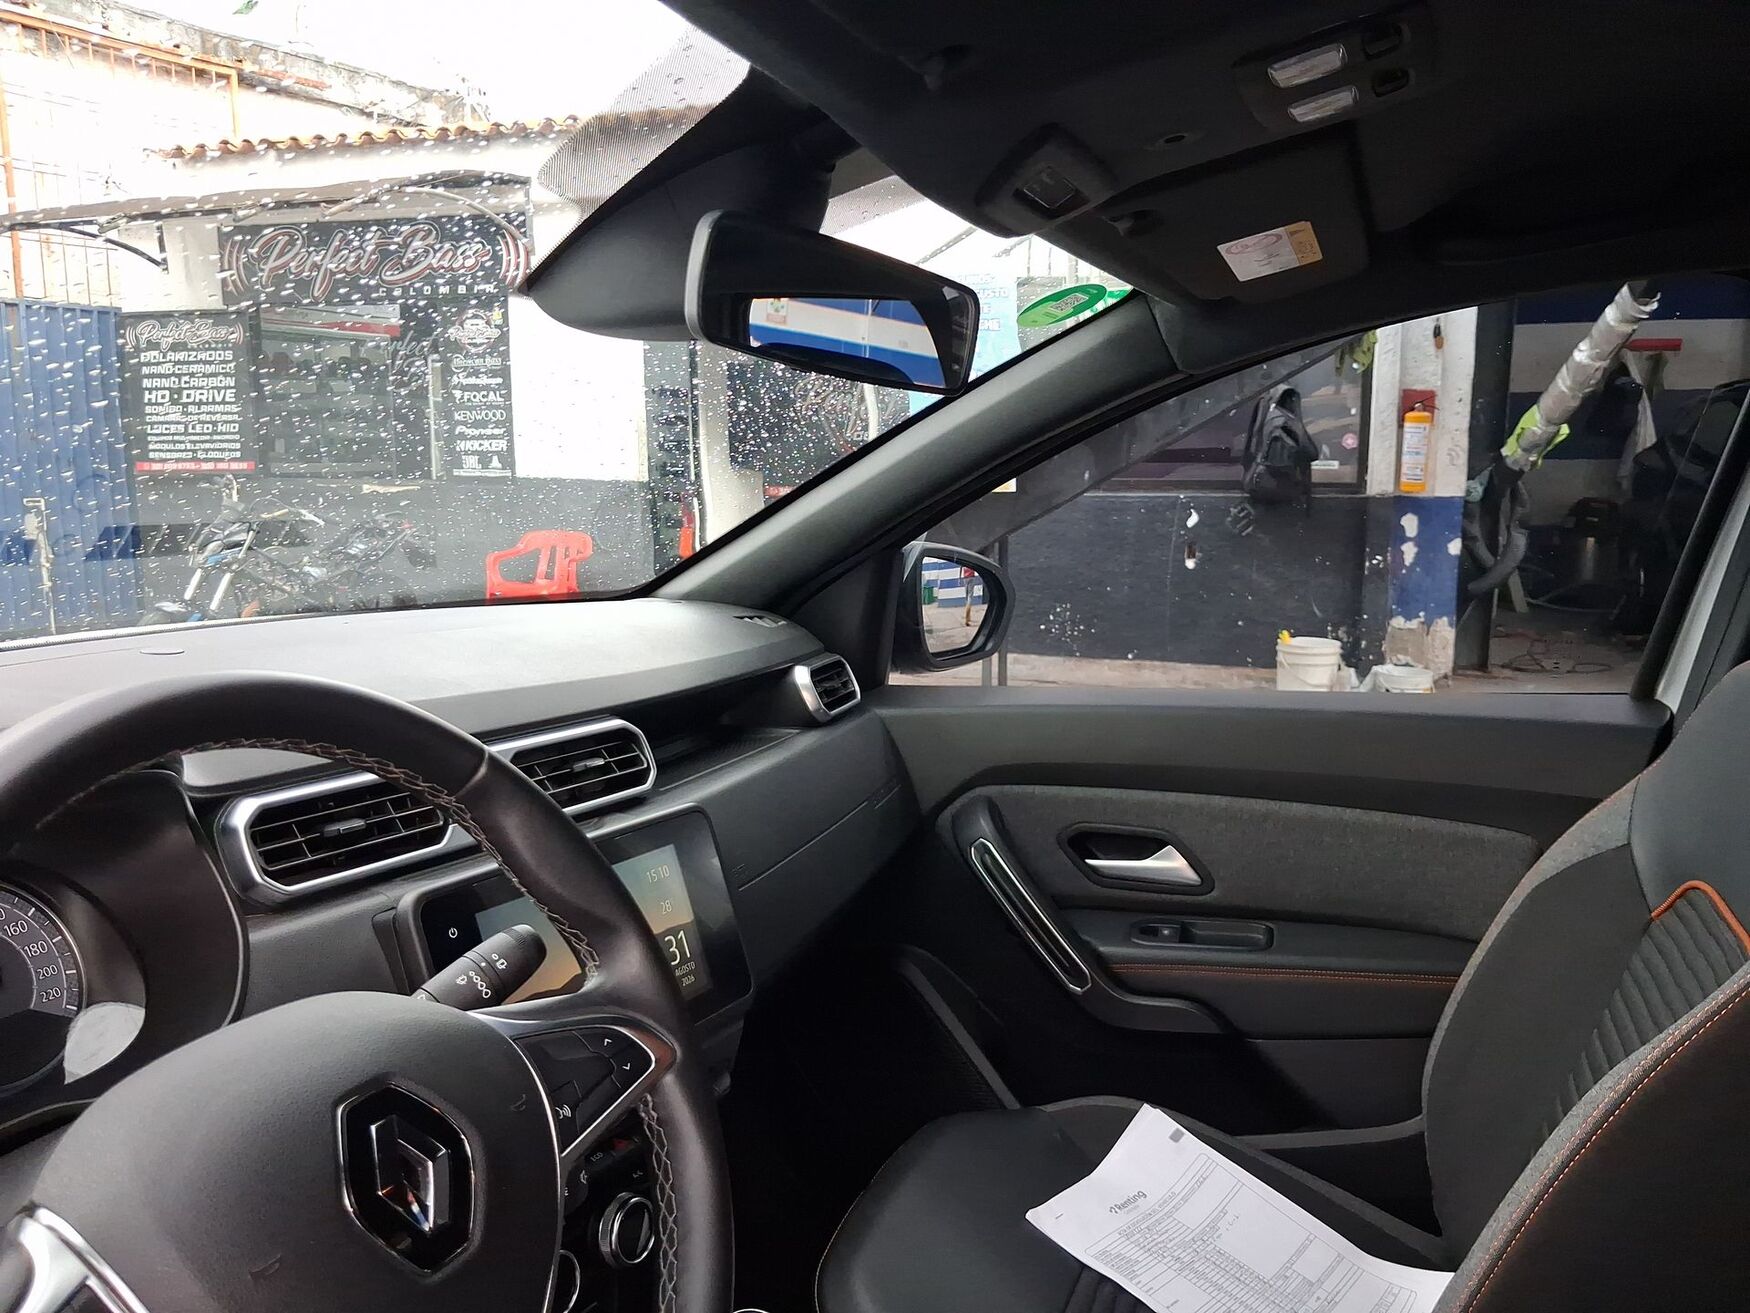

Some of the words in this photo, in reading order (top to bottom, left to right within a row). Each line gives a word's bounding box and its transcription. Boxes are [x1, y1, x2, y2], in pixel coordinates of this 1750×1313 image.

[252, 226, 386, 300] Perfect
[380, 221, 492, 287] Bass
[379, 284, 496, 297] COLOMBIA
[136, 320, 191, 352] Perfect
[187, 319, 231, 345] Bass
[140, 350, 234, 363] POLARIZADOS
[144, 389, 171, 404] HD
[180, 388, 237, 403] DRIVE
[464, 390, 505, 402] FOCAL
[454, 409, 507, 421] KENWOOD
[188, 423, 213, 433] LED
[217, 423, 240, 433] HID
[461, 455, 482, 469] JBL
[4, 920, 28, 937] 160
[24, 940, 48, 957] 180
[664, 929, 691, 966] 31
[37, 964, 58, 980] 200
[675, 961, 696, 977] AGOSTO
[40, 987, 61, 1002] 220
[1112, 1190, 1148, 1211] Renting
